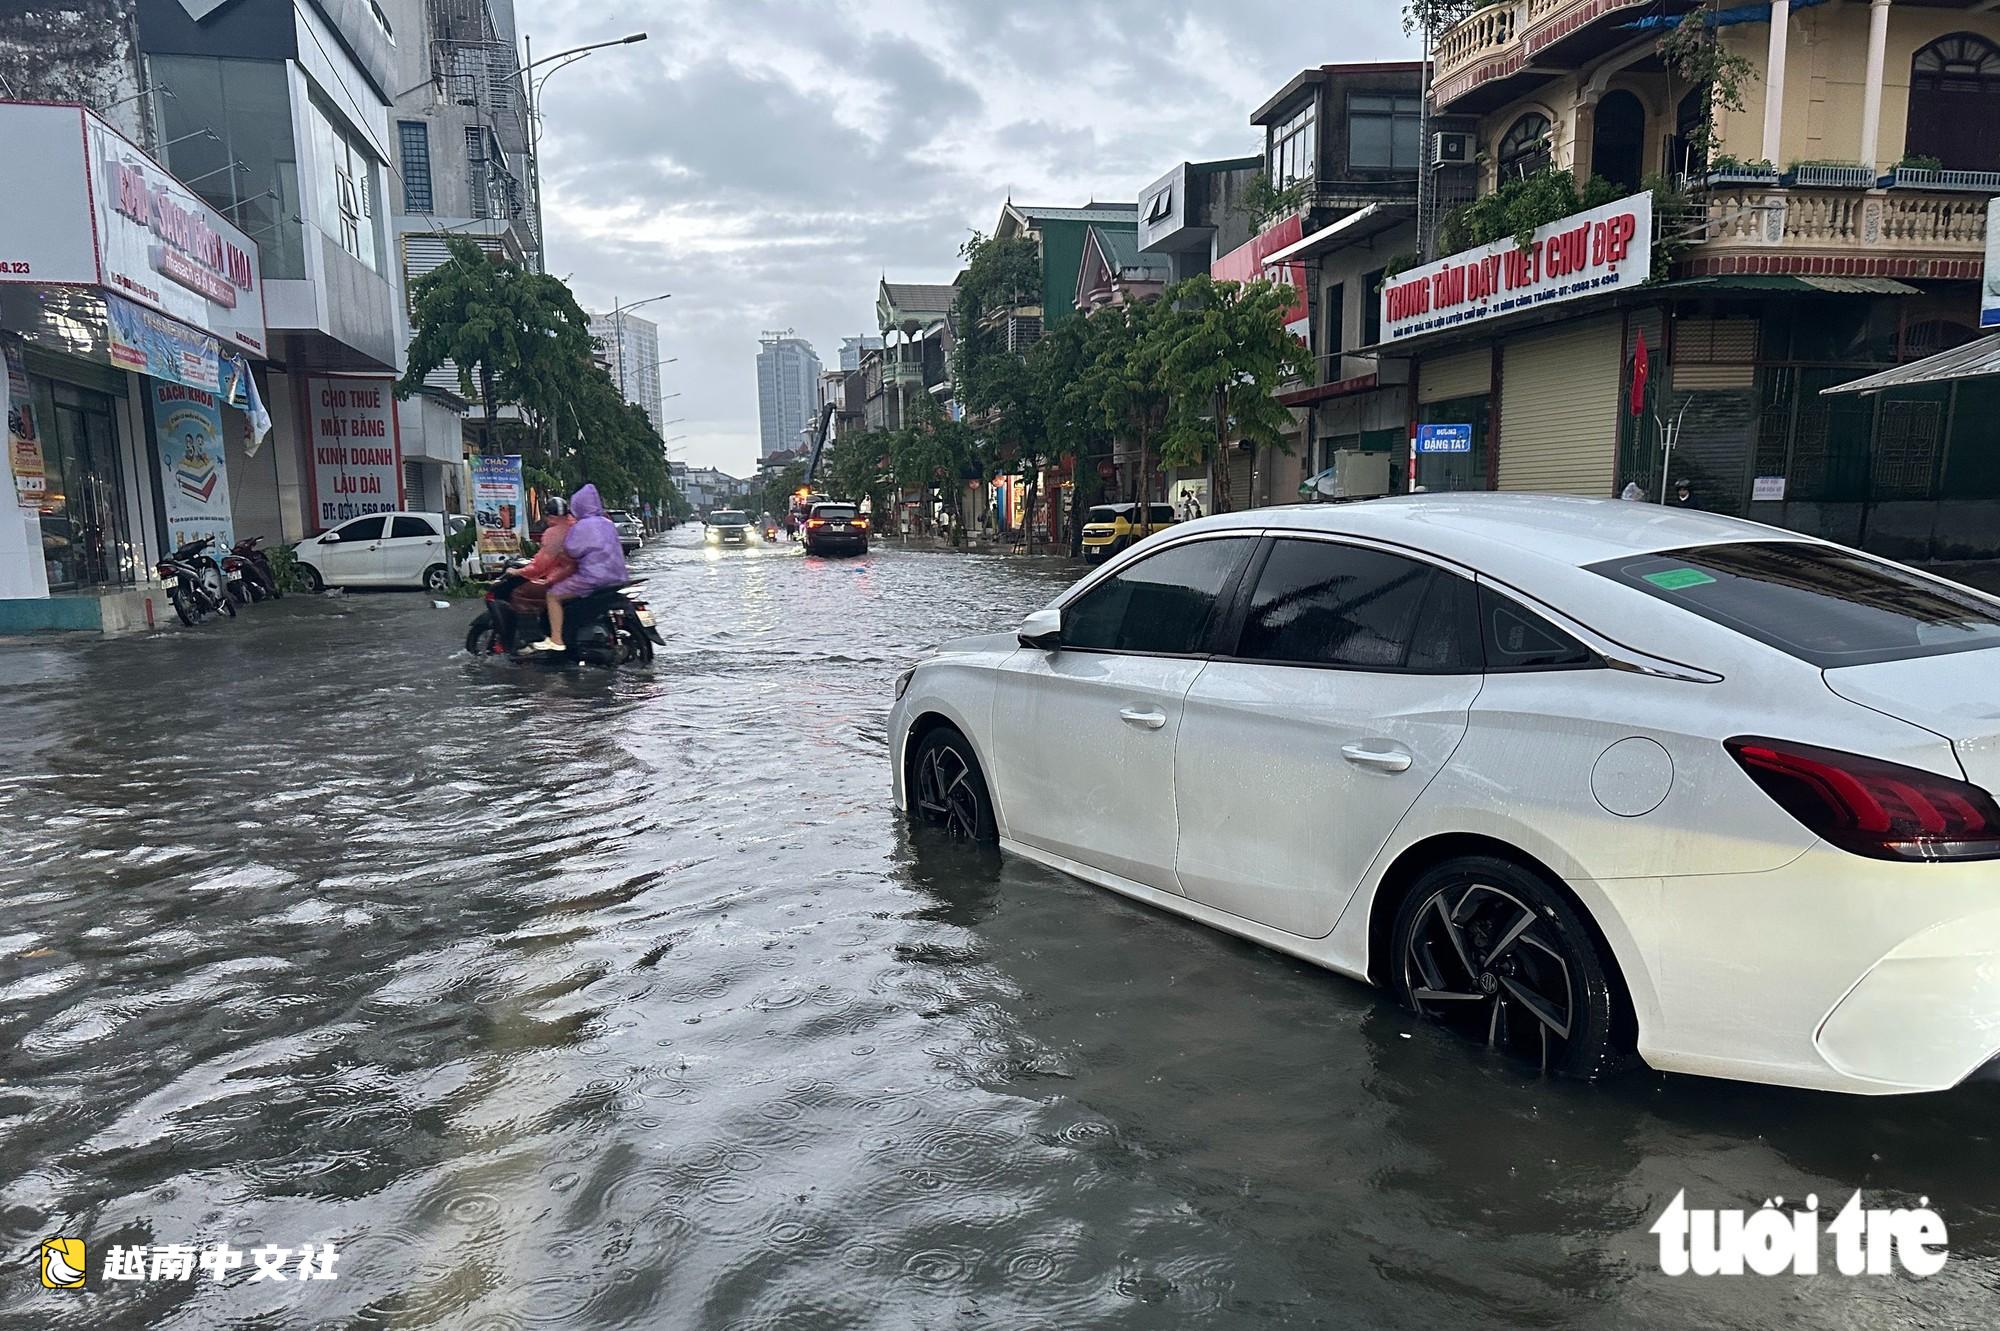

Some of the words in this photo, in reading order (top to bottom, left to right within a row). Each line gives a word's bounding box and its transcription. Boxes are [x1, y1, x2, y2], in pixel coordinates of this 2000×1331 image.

[0, 261, 30, 274] 9.123
[226, 240, 253, 292] KHOA
[1386, 276, 1430, 323] TRUNG
[1432, 263, 1465, 310] TÂM
[1467, 254, 1501, 304] DẠY
[1592, 213, 1636, 272] ĐẸP
[188, 387, 213, 408] KHOA
[321, 390, 346, 408] CHO
[350, 387, 381, 409] THUÊ
[352, 413, 385, 437] BẰNG
[1424, 437, 1448, 451] ĐẶNG
[318, 447, 348, 465] KINH
[351, 448, 393, 465] DOANH
[360, 473, 381, 493] DÀI
[322, 503, 336, 520] ĐT:
